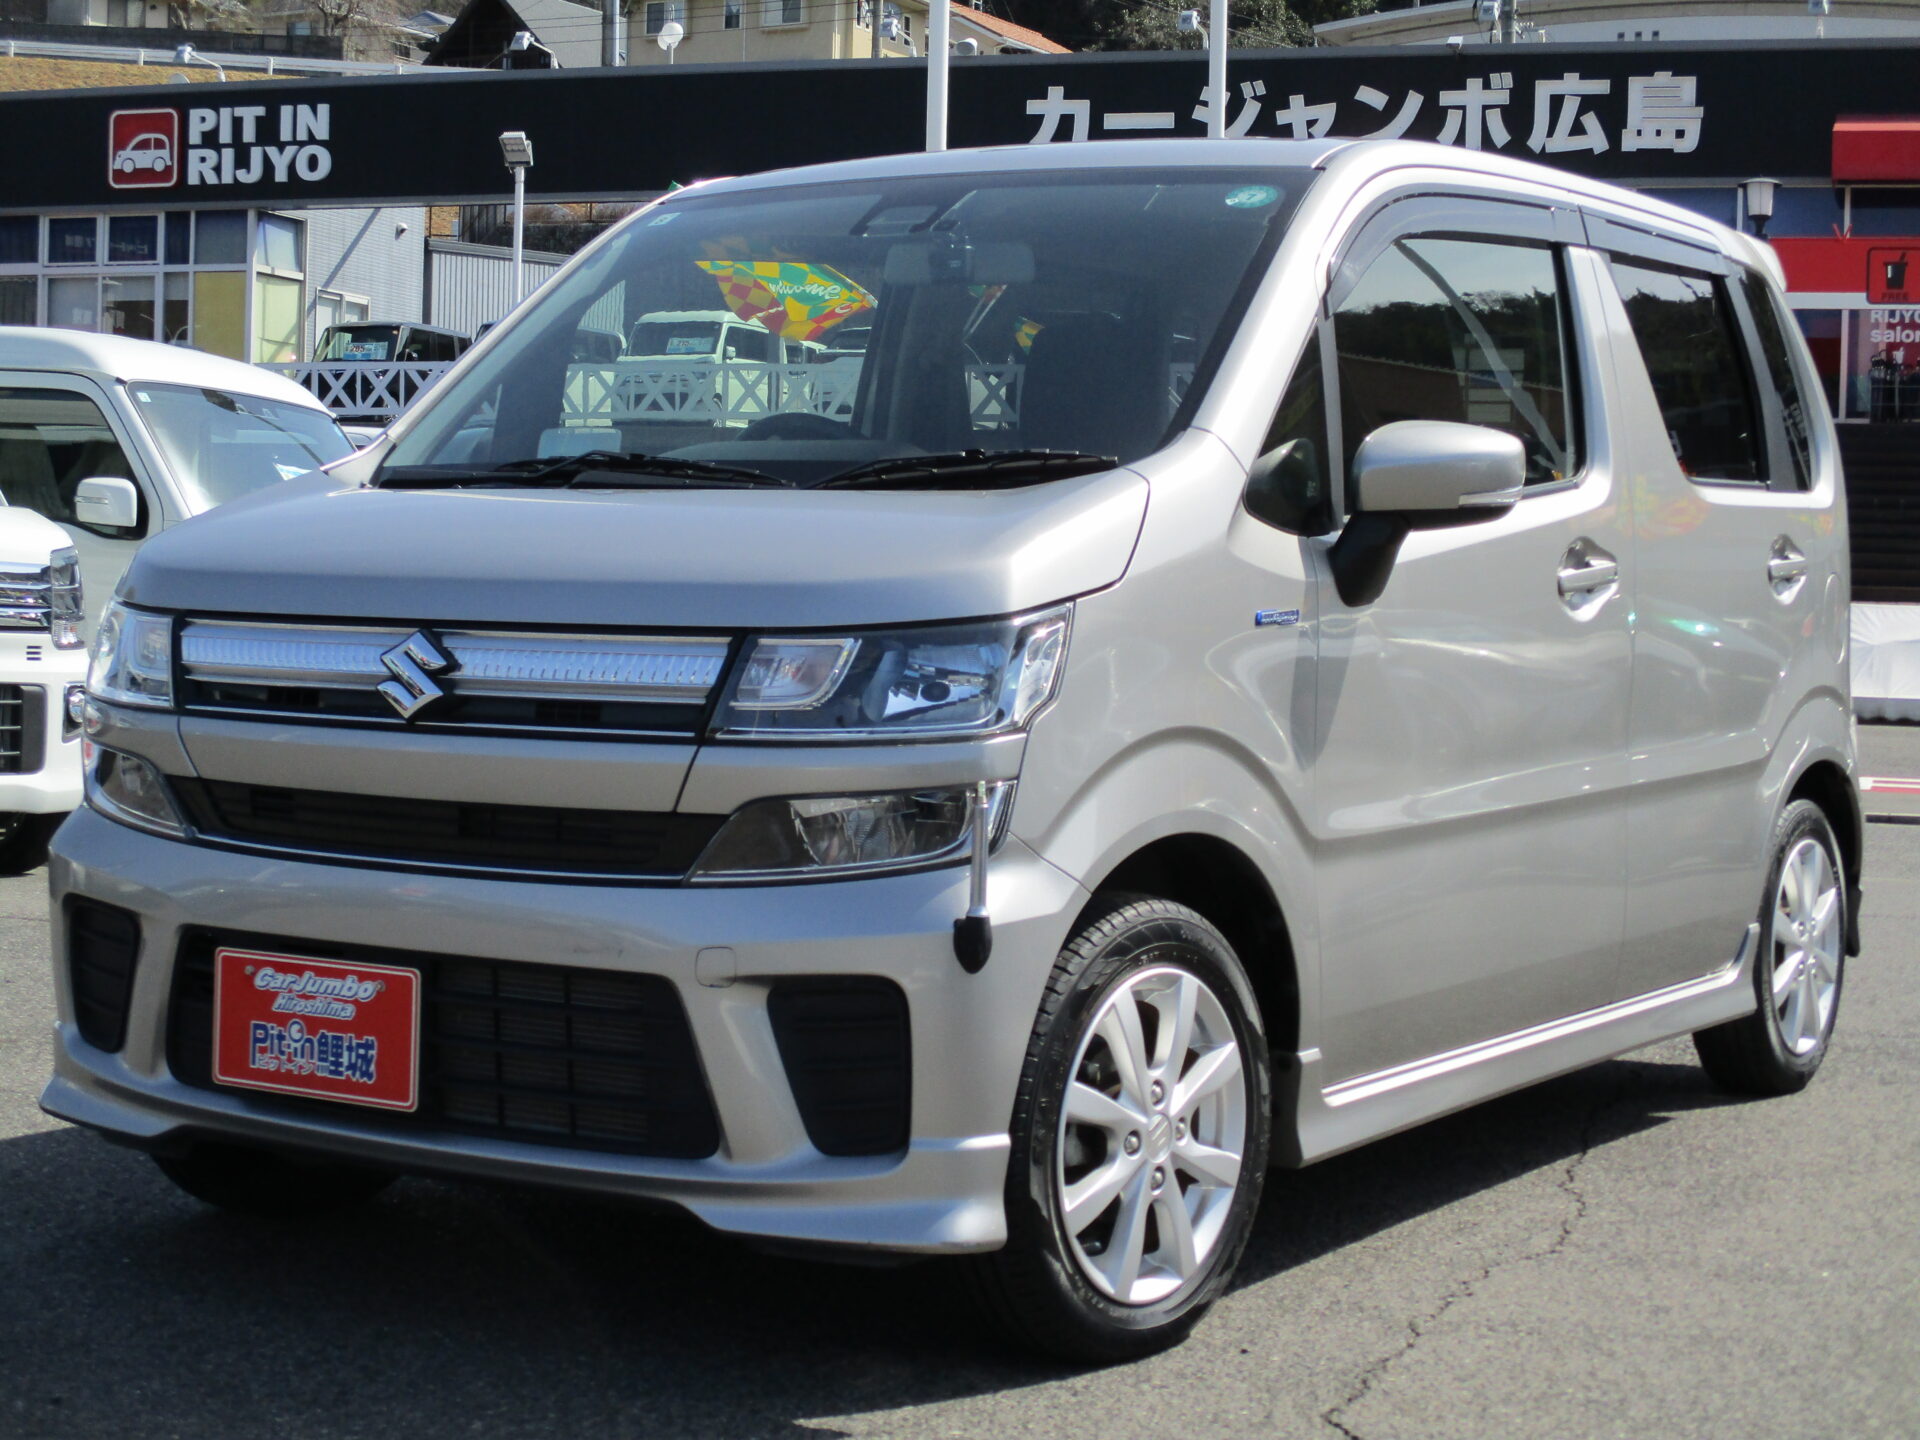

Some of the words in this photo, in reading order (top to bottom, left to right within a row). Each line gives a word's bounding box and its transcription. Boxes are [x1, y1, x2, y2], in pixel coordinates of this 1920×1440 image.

[189, 106, 266, 144] PIT
[280, 104, 330, 142] IN
[187, 145, 332, 185] RIJYO
[272, 993, 356, 1020] Hiroshima
